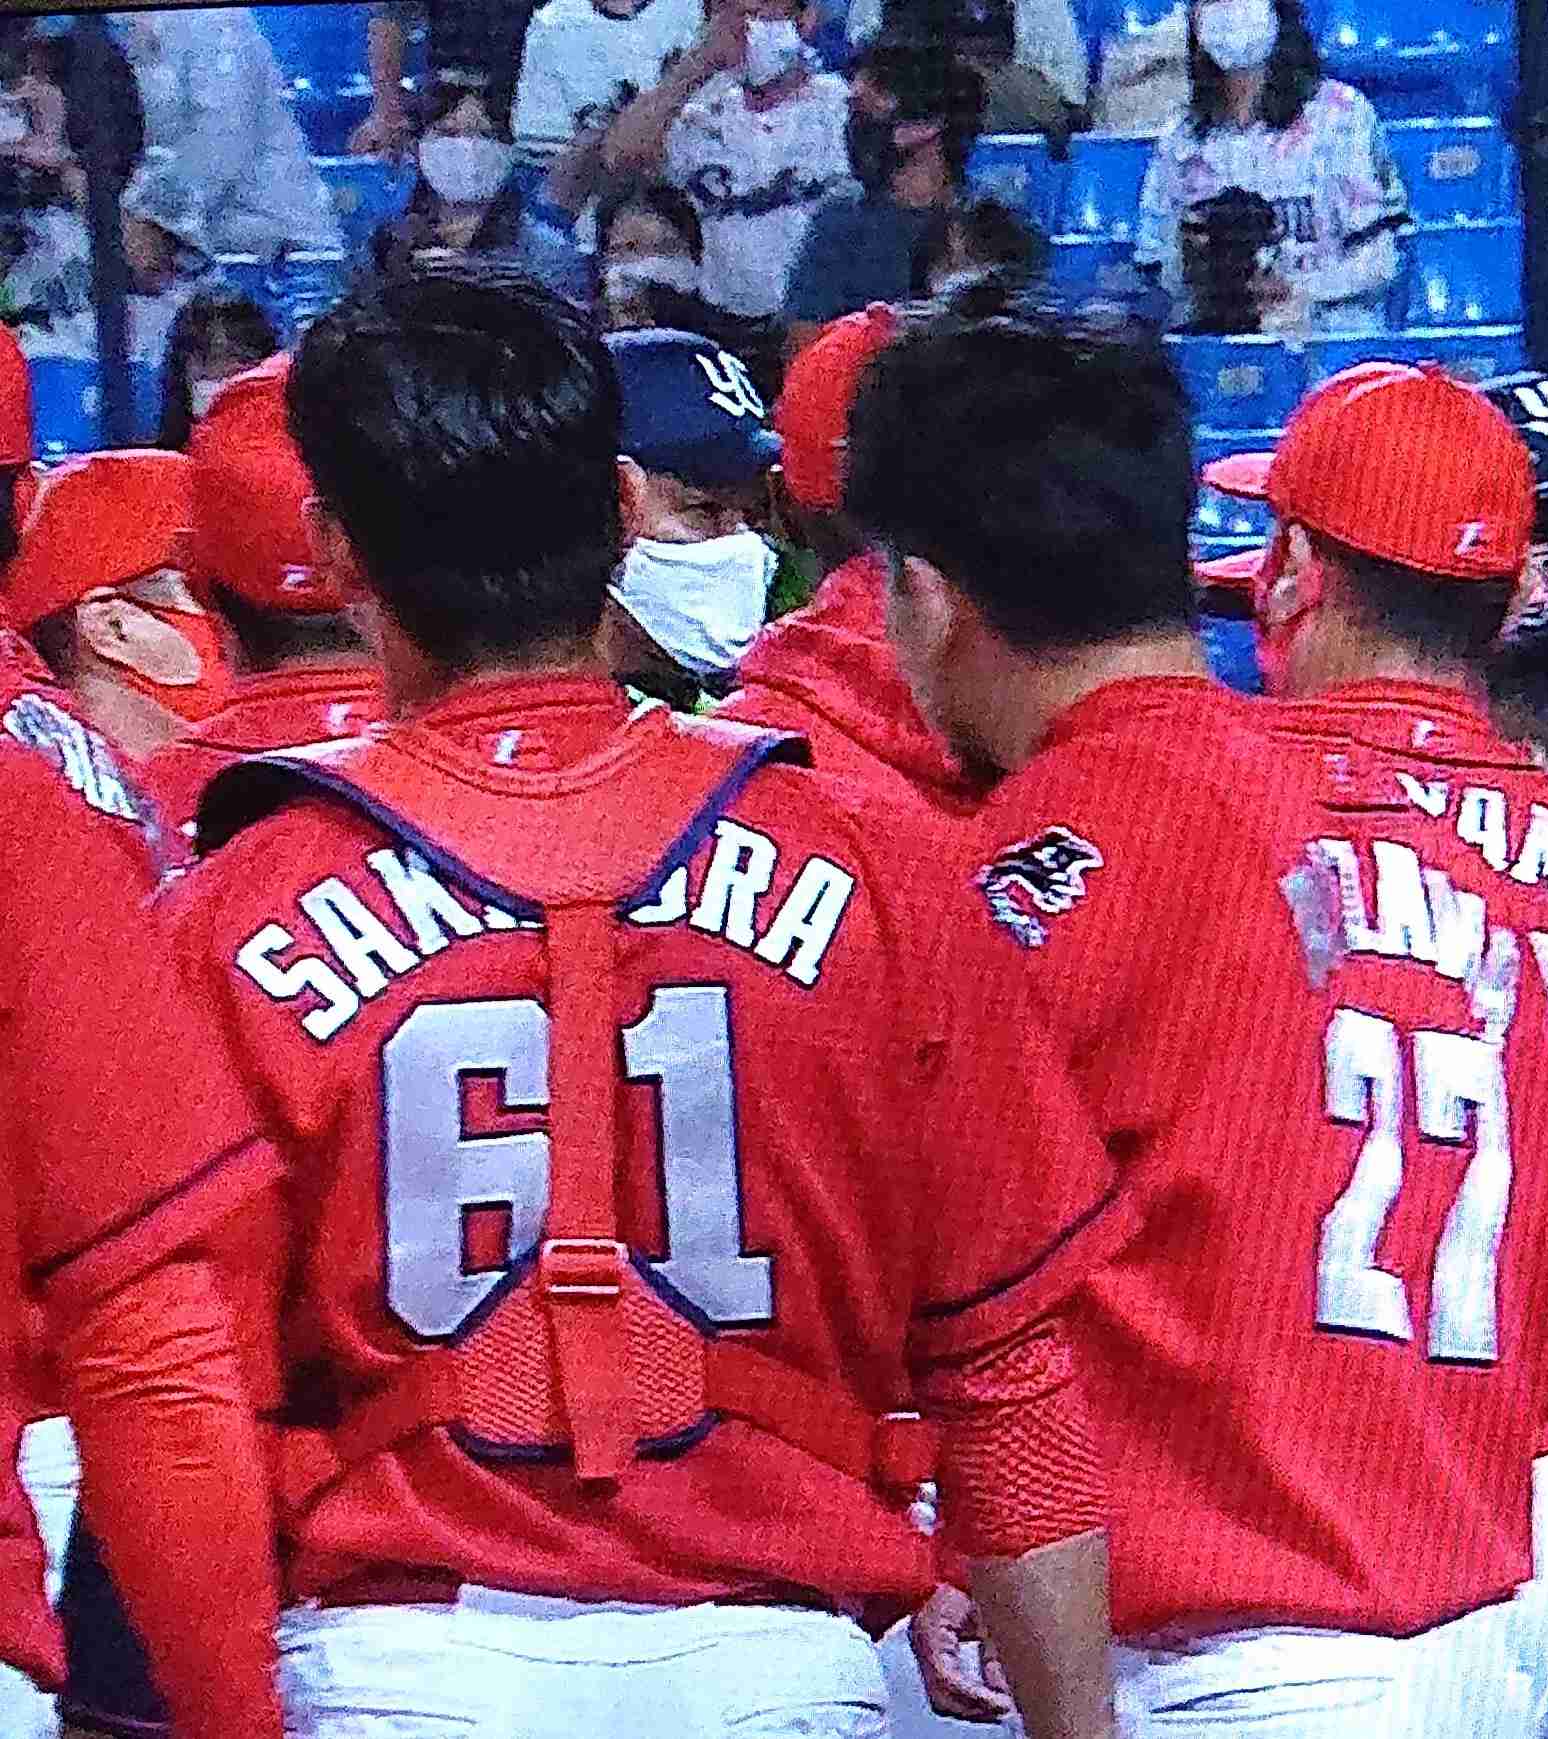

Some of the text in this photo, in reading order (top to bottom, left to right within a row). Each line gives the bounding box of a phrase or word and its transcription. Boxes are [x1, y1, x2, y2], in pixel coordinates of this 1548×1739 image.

[234, 817, 857, 1043] SAKRA
[382, 984, 775, 1340] 61
[1315, 1005, 1514, 1364] 27
